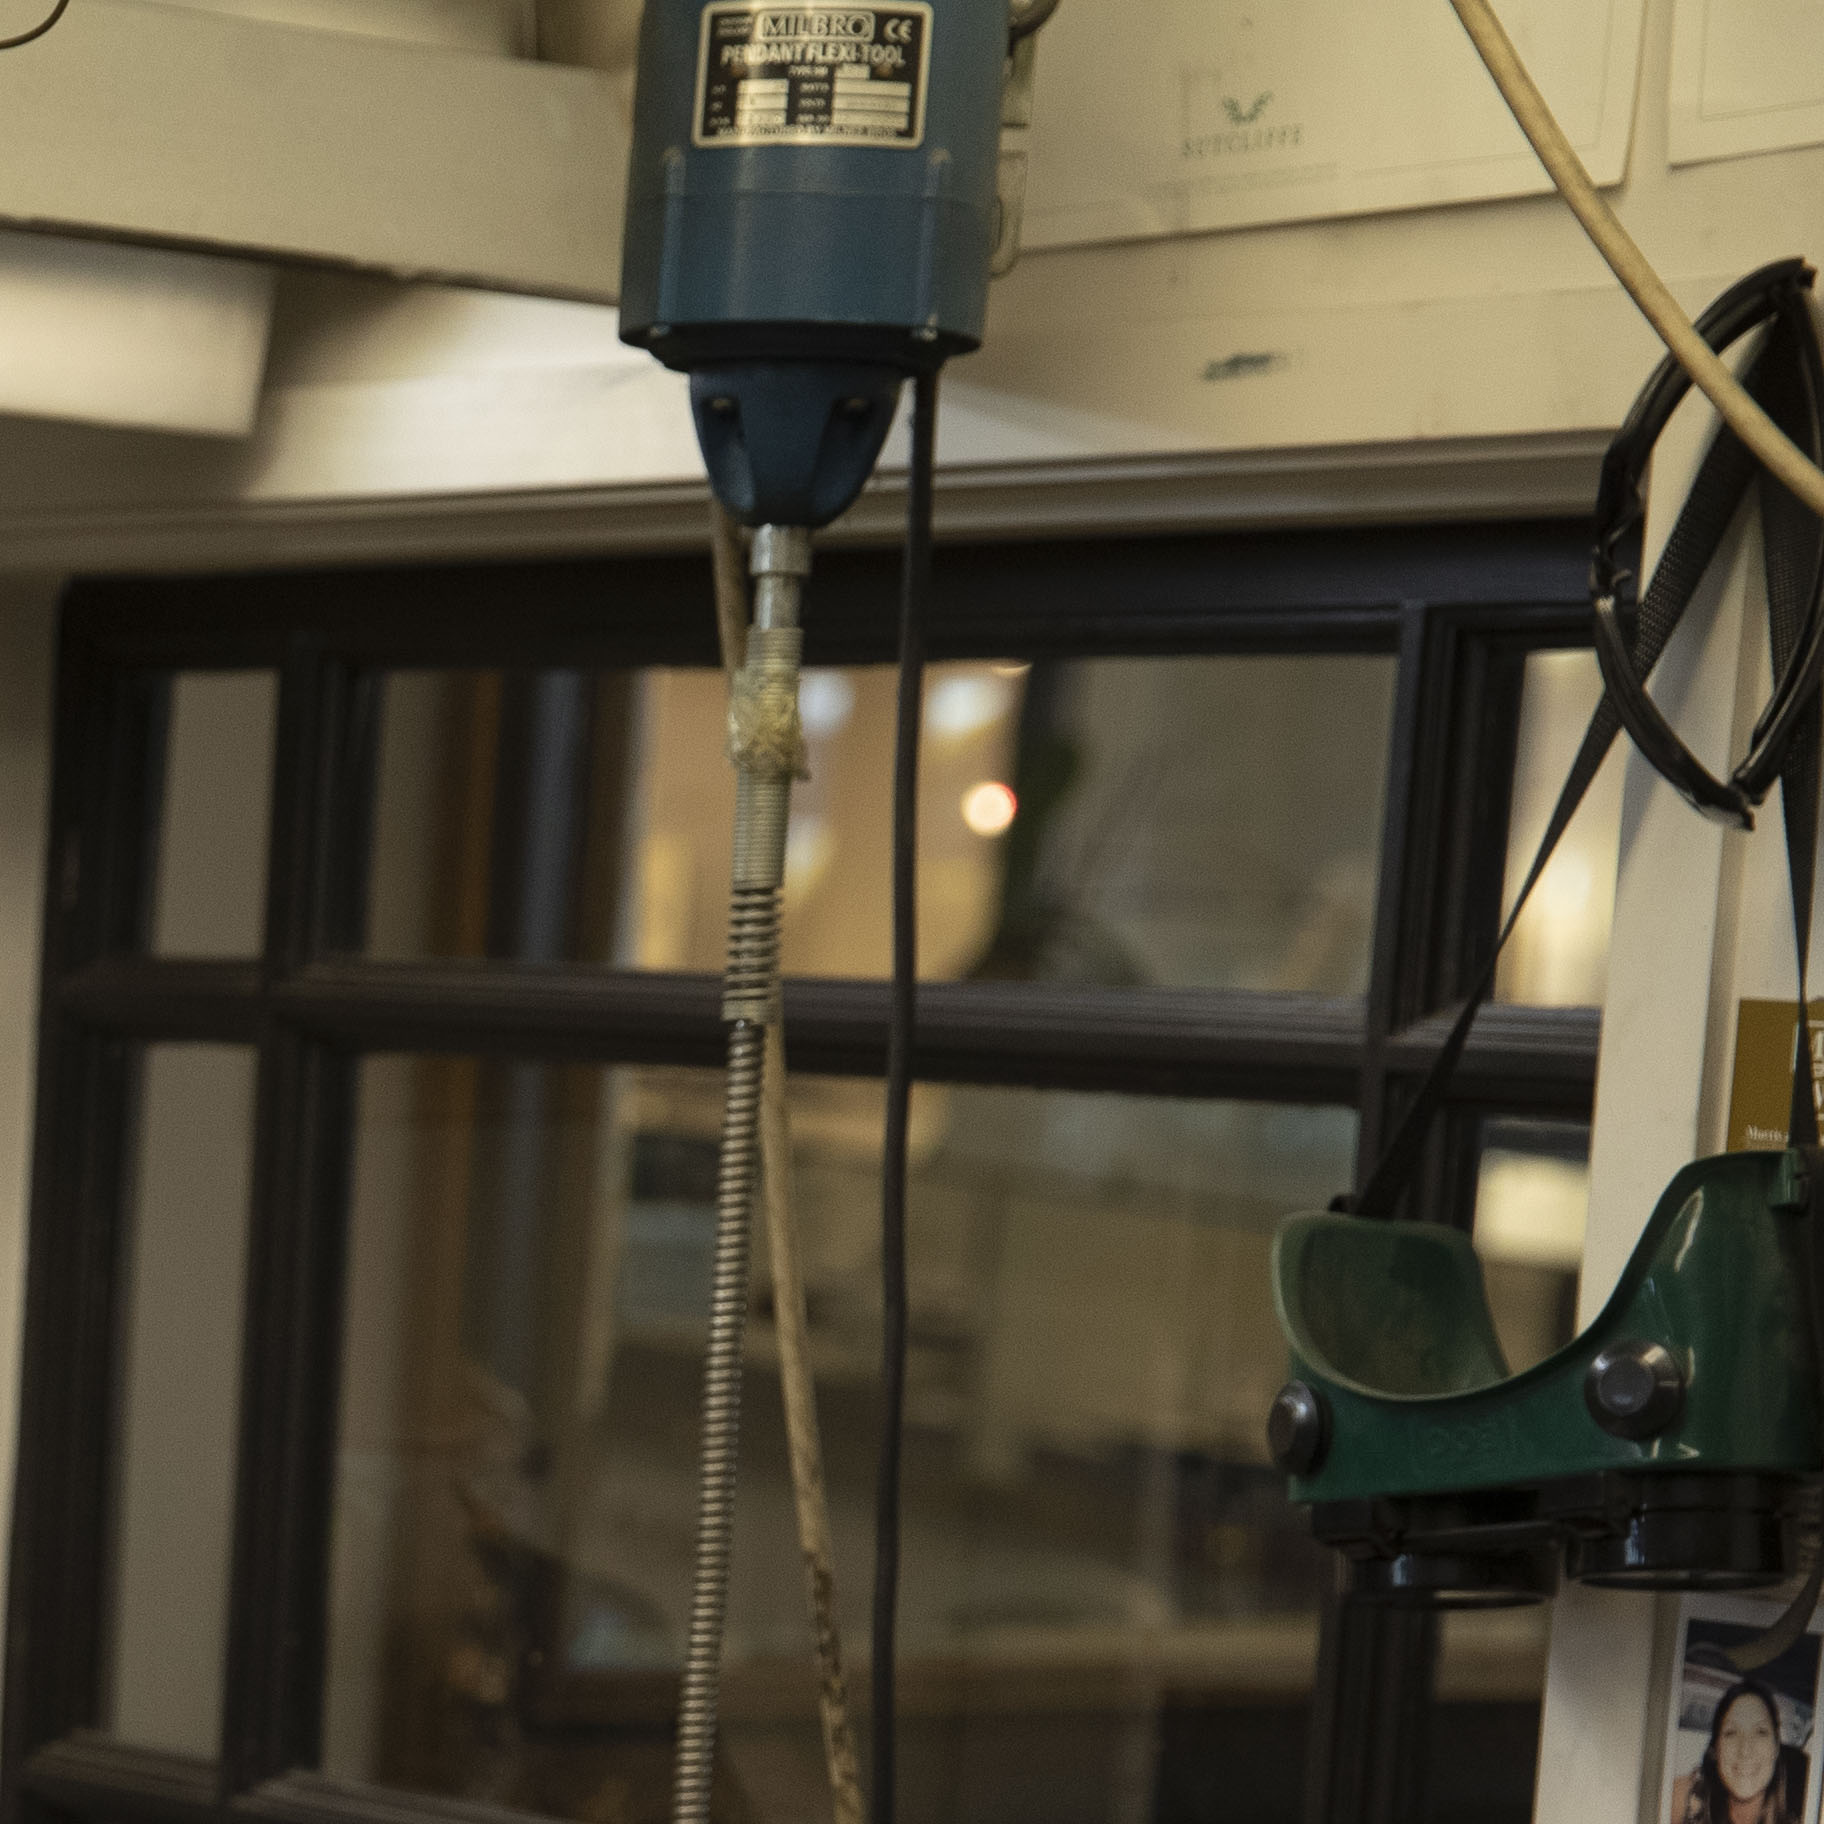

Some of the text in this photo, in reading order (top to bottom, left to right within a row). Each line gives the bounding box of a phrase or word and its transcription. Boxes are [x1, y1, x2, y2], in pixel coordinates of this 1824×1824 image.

[762, 14, 870, 38] MILBRO
[720, 42, 907, 67] PENDANT FLEXI-TOOL
[1181, 124, 1303, 158] SUTCLIFFE
